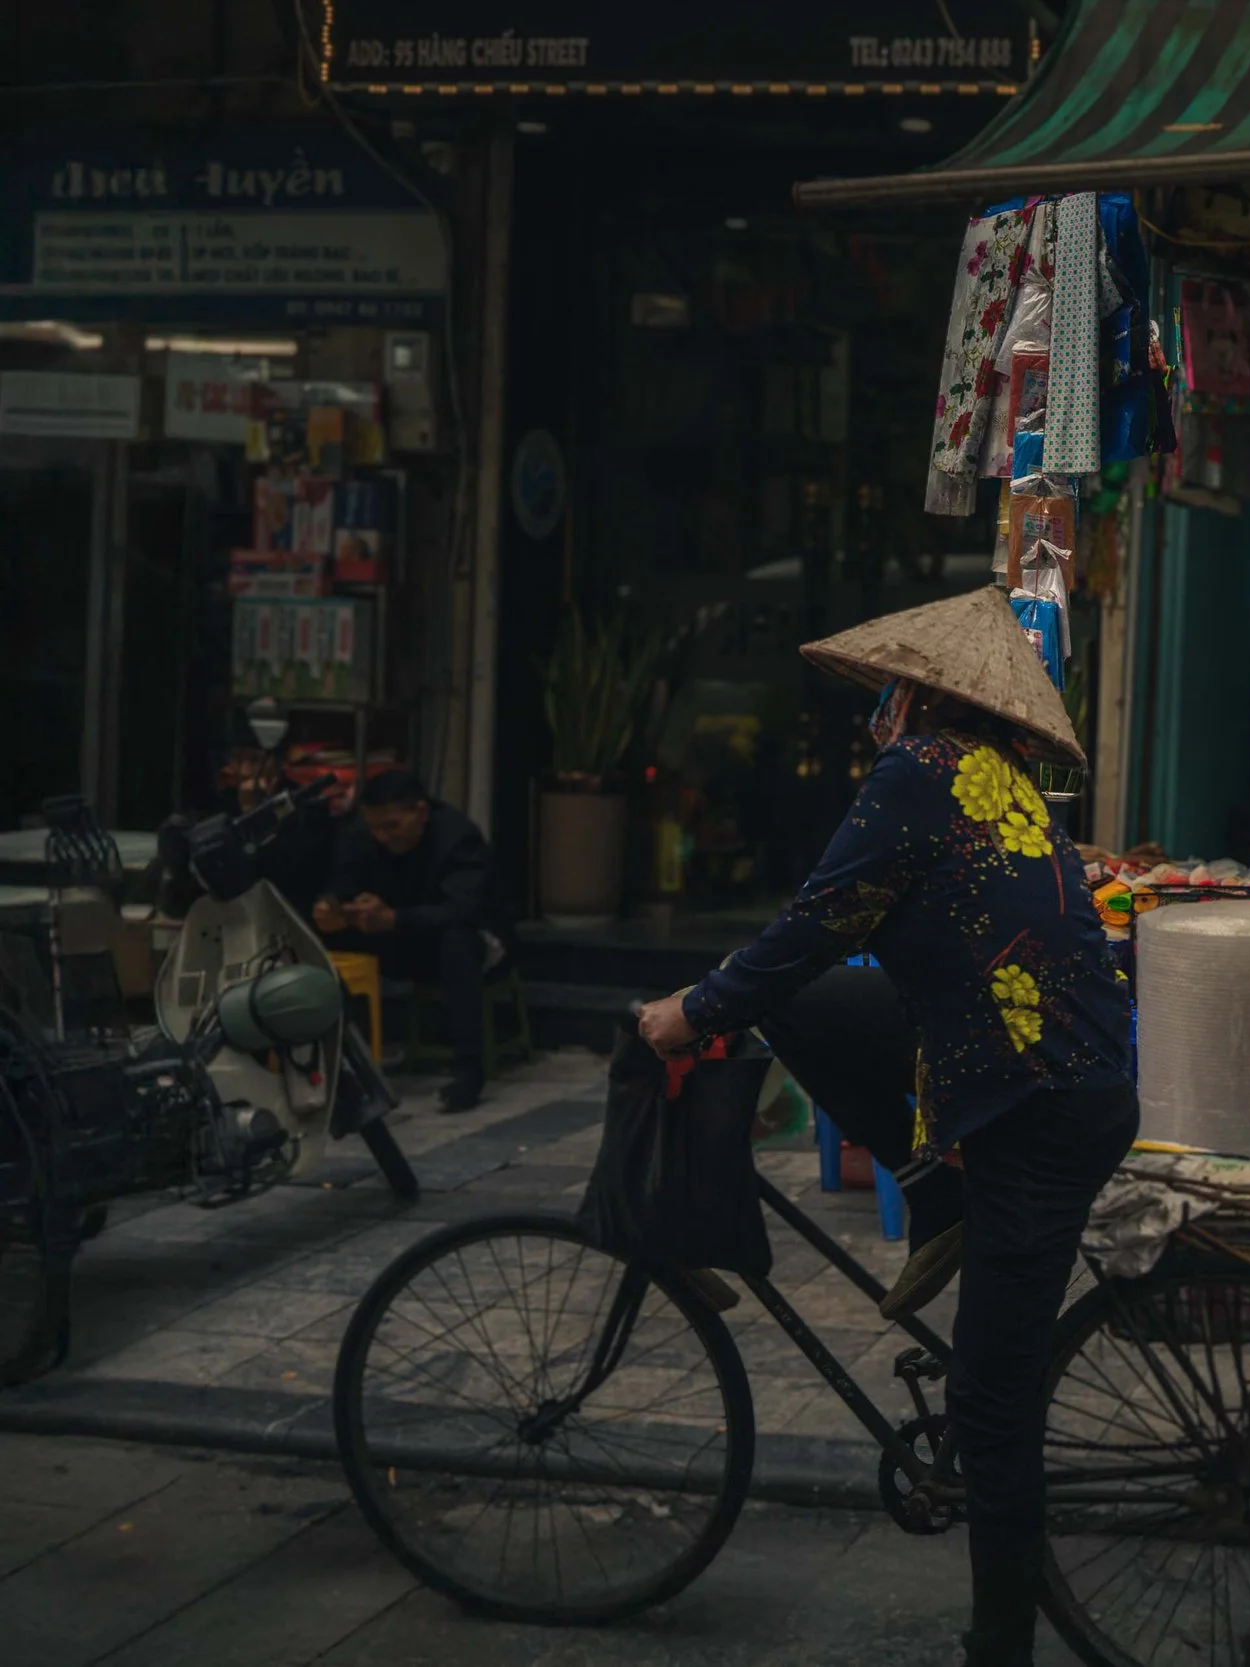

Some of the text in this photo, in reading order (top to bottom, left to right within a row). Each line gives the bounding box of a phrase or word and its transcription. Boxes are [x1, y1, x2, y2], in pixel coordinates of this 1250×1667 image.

[347, 39, 389, 67] ADD:
[417, 31, 468, 67] HÀNG
[470, 28, 523, 67] CHIẾU
[526, 37, 590, 67] STREET
[849, 37, 889, 68] TEL:
